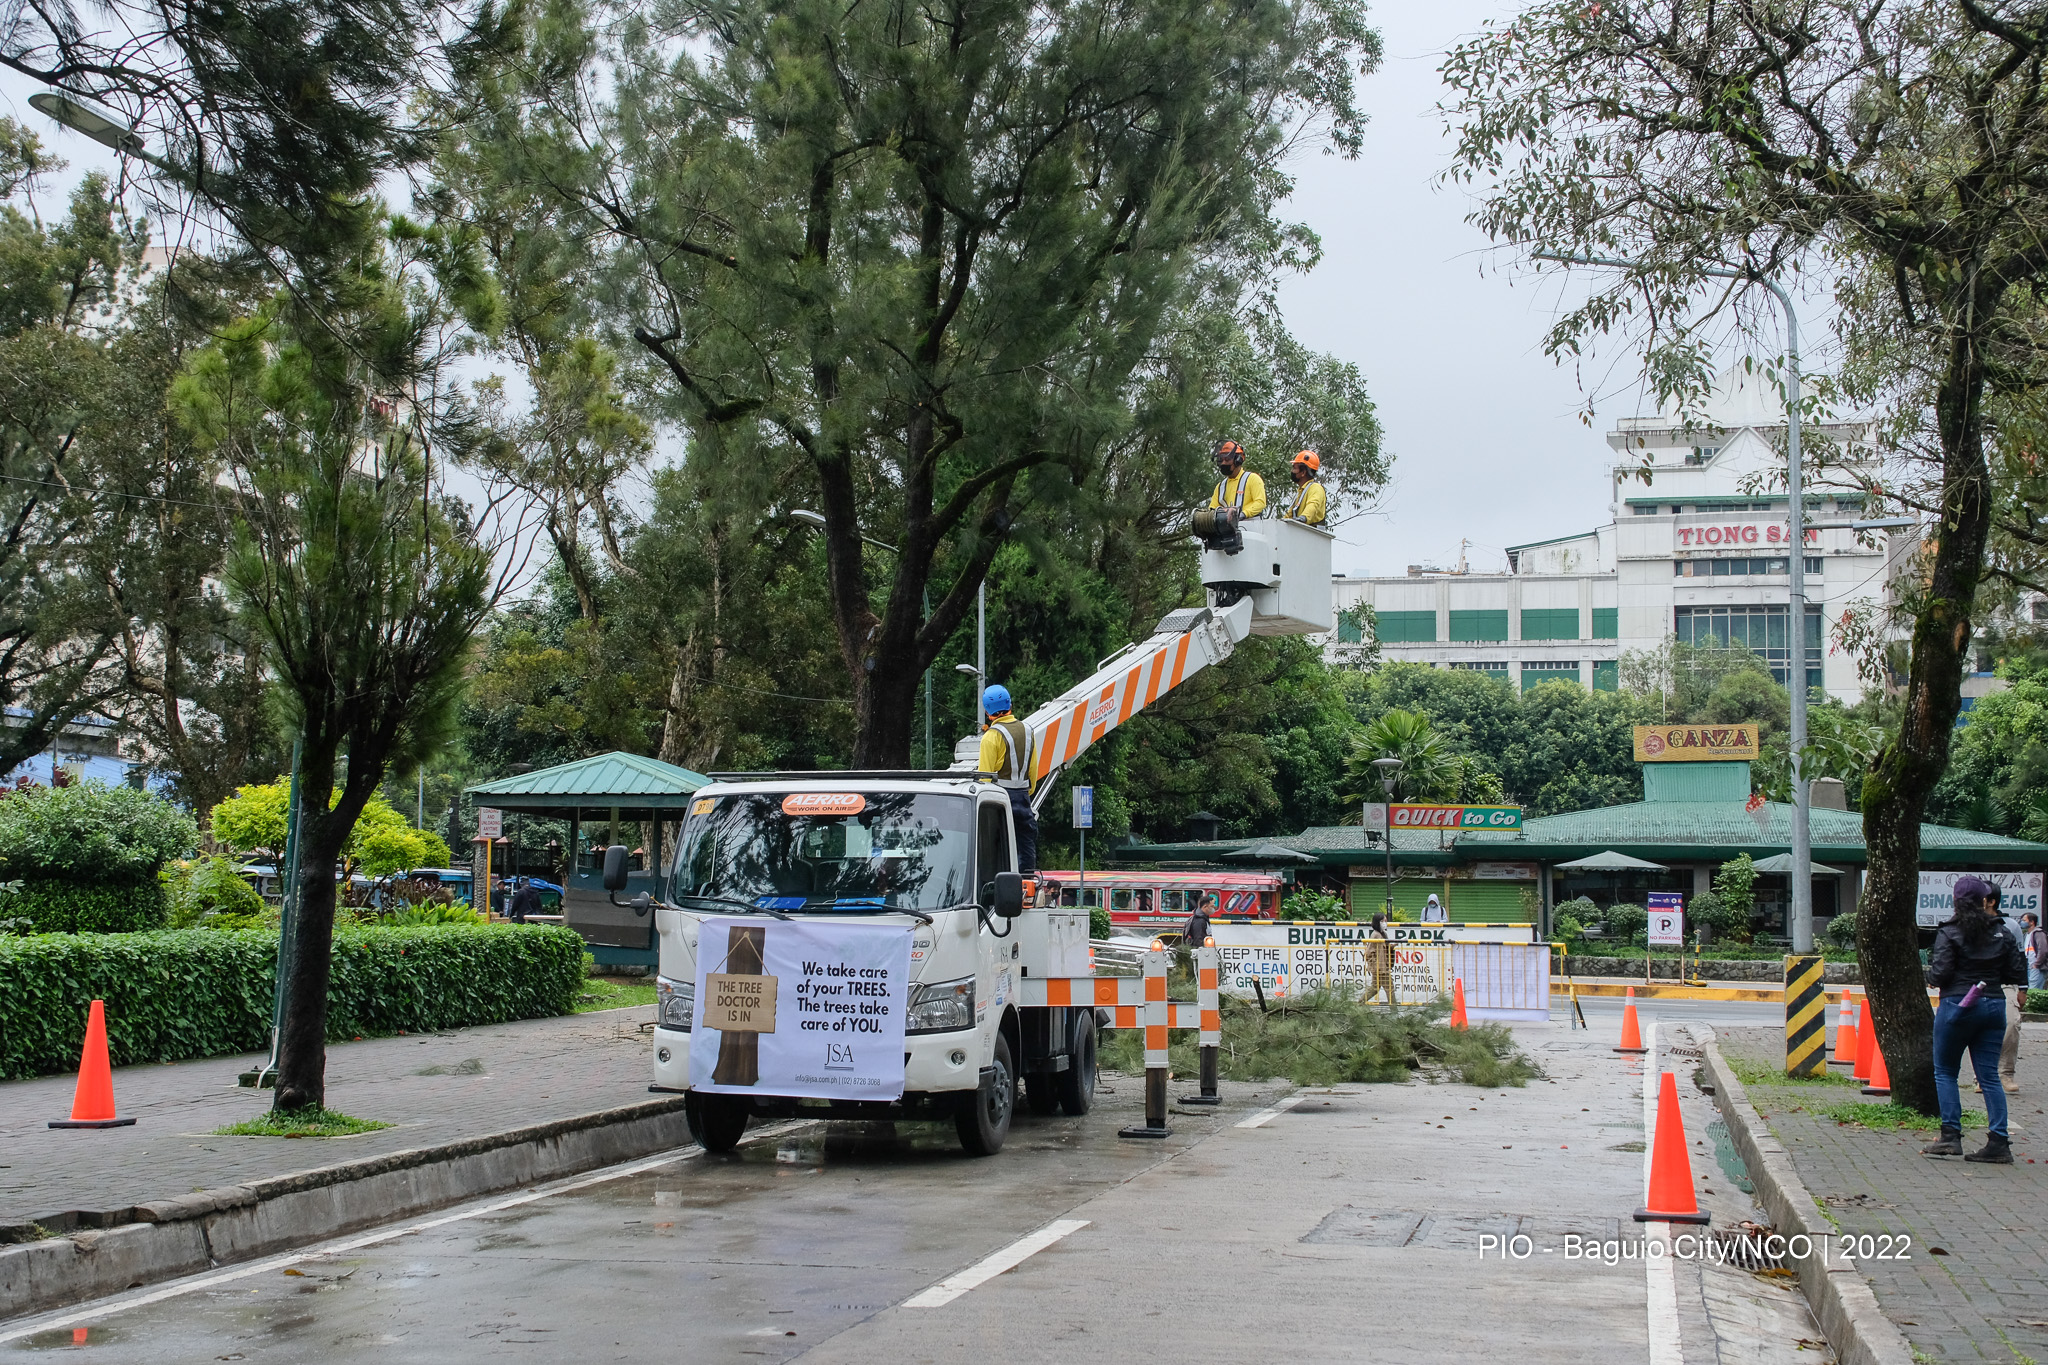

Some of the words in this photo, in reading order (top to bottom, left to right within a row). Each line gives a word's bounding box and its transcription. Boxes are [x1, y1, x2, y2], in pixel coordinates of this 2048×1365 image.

[1678, 526, 1759, 545] TIONG
[1089, 698, 1114, 722] AERRO
[1667, 730, 1752, 748] GANZA
[787, 794, 858, 805] AERRO
[1394, 809, 1460, 826] QUICK
[1464, 812, 1486, 825] to
[1489, 812, 1516, 825] Go
[1395, 930, 1446, 946] PARK
[1254, 949, 1279, 960] THE
[1336, 950, 1365, 961] CITY
[1396, 951, 1423, 964] NO
[802, 962, 823, 977] We
[827, 964, 856, 977] take
[860, 967, 888, 978] care
[1244, 963, 1288, 974] CLEAN
[1296, 964, 1324, 975] ORD.
[718, 981, 735, 993] THE
[739, 982, 762, 994] TREE
[797, 979, 810, 994] of
[813, 984, 843, 998] your
[848, 982, 890, 997] TREES.
[1404, 984, 1438, 992] MOMMA
[717, 996, 760, 1008] DOCTOR
[798, 998, 820, 1012] The
[824, 1001, 856, 1014] trees
[860, 1002, 889, 1015] take
[728, 1010, 737, 1021] IS
[740, 1011, 751, 1022] IN
[801, 1019, 829, 1030] care
[833, 1017, 846, 1031] of
[850, 1018, 882, 1033] YOU.
[824, 1044, 854, 1066] JSA
[795, 1074, 837, 1084] info@jsa.com.ph
[842, 1077, 852, 1086] (02)
[853, 1077, 866, 1085] 8726
[867, 1077, 880, 1086] 3068
